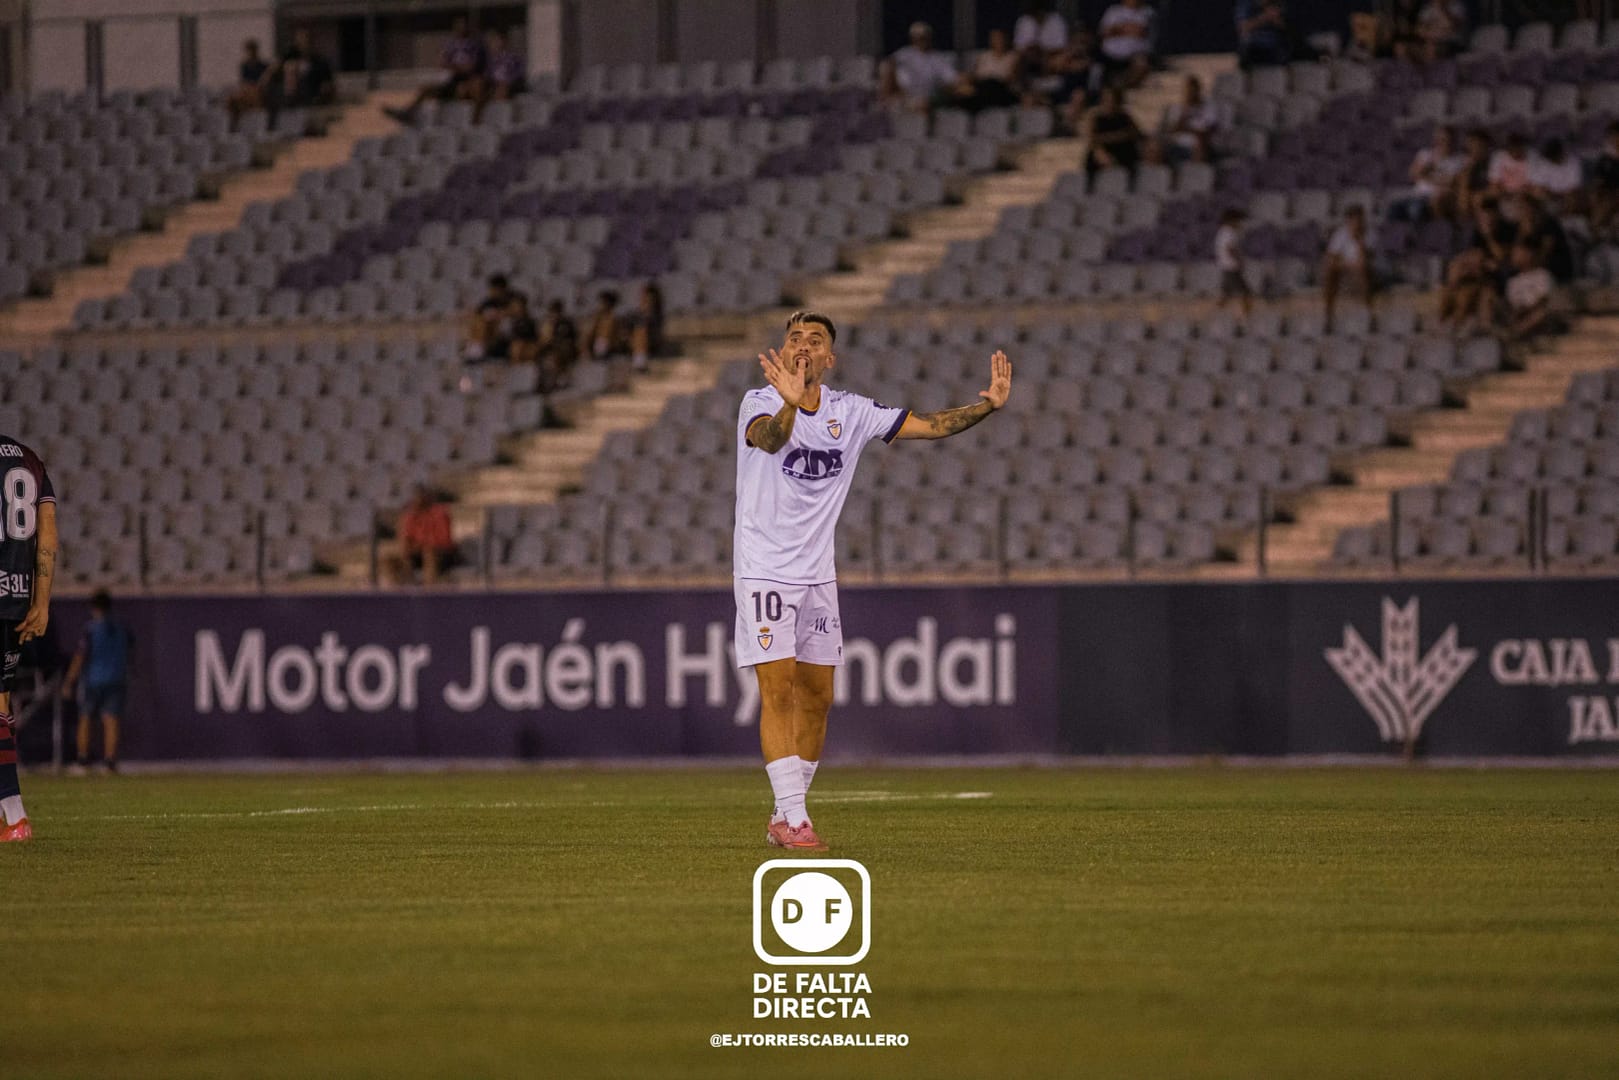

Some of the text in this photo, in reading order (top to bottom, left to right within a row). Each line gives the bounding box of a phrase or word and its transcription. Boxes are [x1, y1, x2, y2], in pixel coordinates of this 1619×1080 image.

[0, 466, 38, 541] 8
[751, 590, 783, 623] 10
[194, 628, 432, 713] Motor
[443, 618, 646, 712] Jaén
[1489, 639, 1599, 687] CAJA
[1567, 695, 1619, 744] JA
